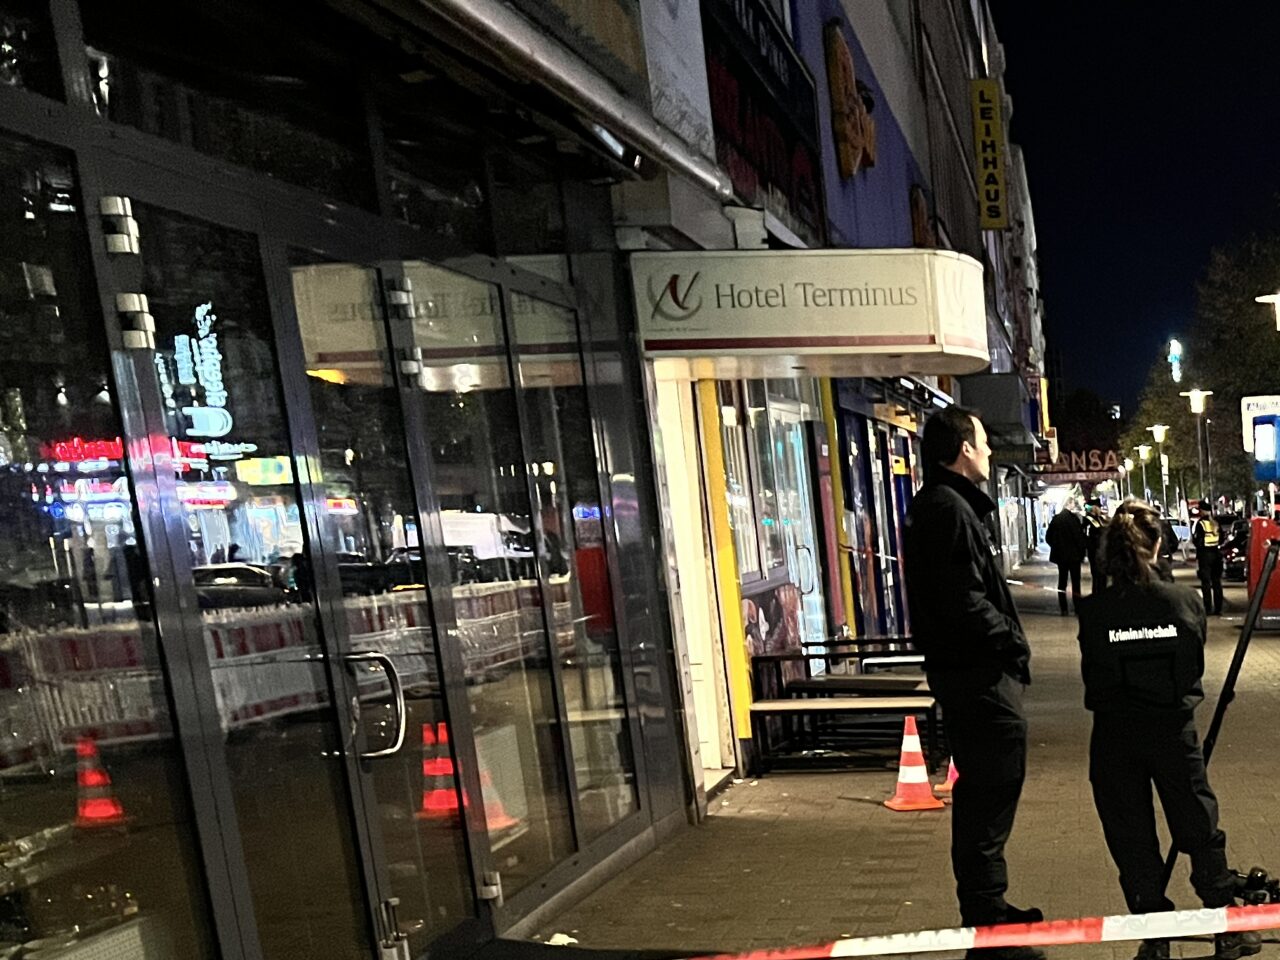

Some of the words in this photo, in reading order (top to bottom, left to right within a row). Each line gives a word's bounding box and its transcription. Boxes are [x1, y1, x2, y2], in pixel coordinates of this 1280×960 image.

[978, 89, 1001, 219] LEIHHAUS
[714, 283, 787, 309] Hotel
[794, 282, 918, 308] Terminus
[1047, 449, 1120, 472] ANSA
